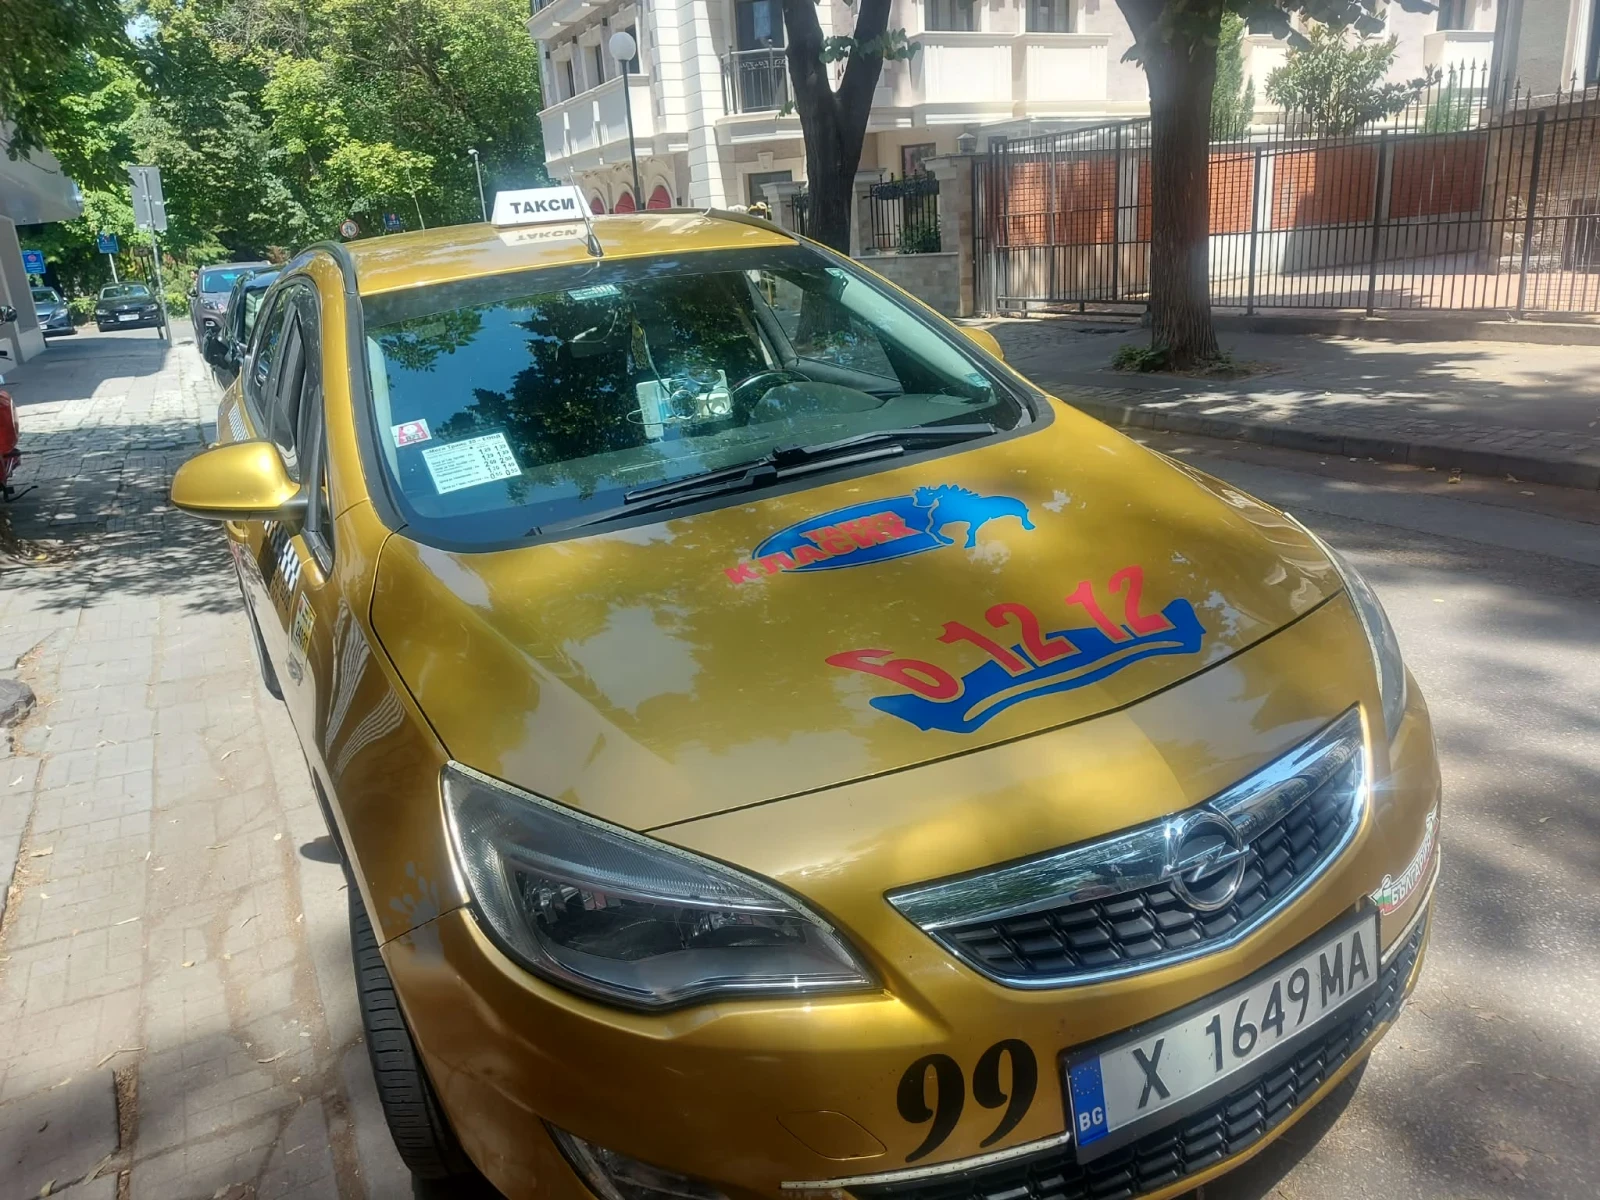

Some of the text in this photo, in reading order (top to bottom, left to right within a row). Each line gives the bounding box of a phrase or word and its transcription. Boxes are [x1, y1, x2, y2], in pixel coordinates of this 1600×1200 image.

[510, 198, 574, 214] ТАКСИ
[1206, 967, 1310, 1073] 1649
[896, 1038, 1038, 1164] 99
[1078, 1106, 1105, 1133] BG
